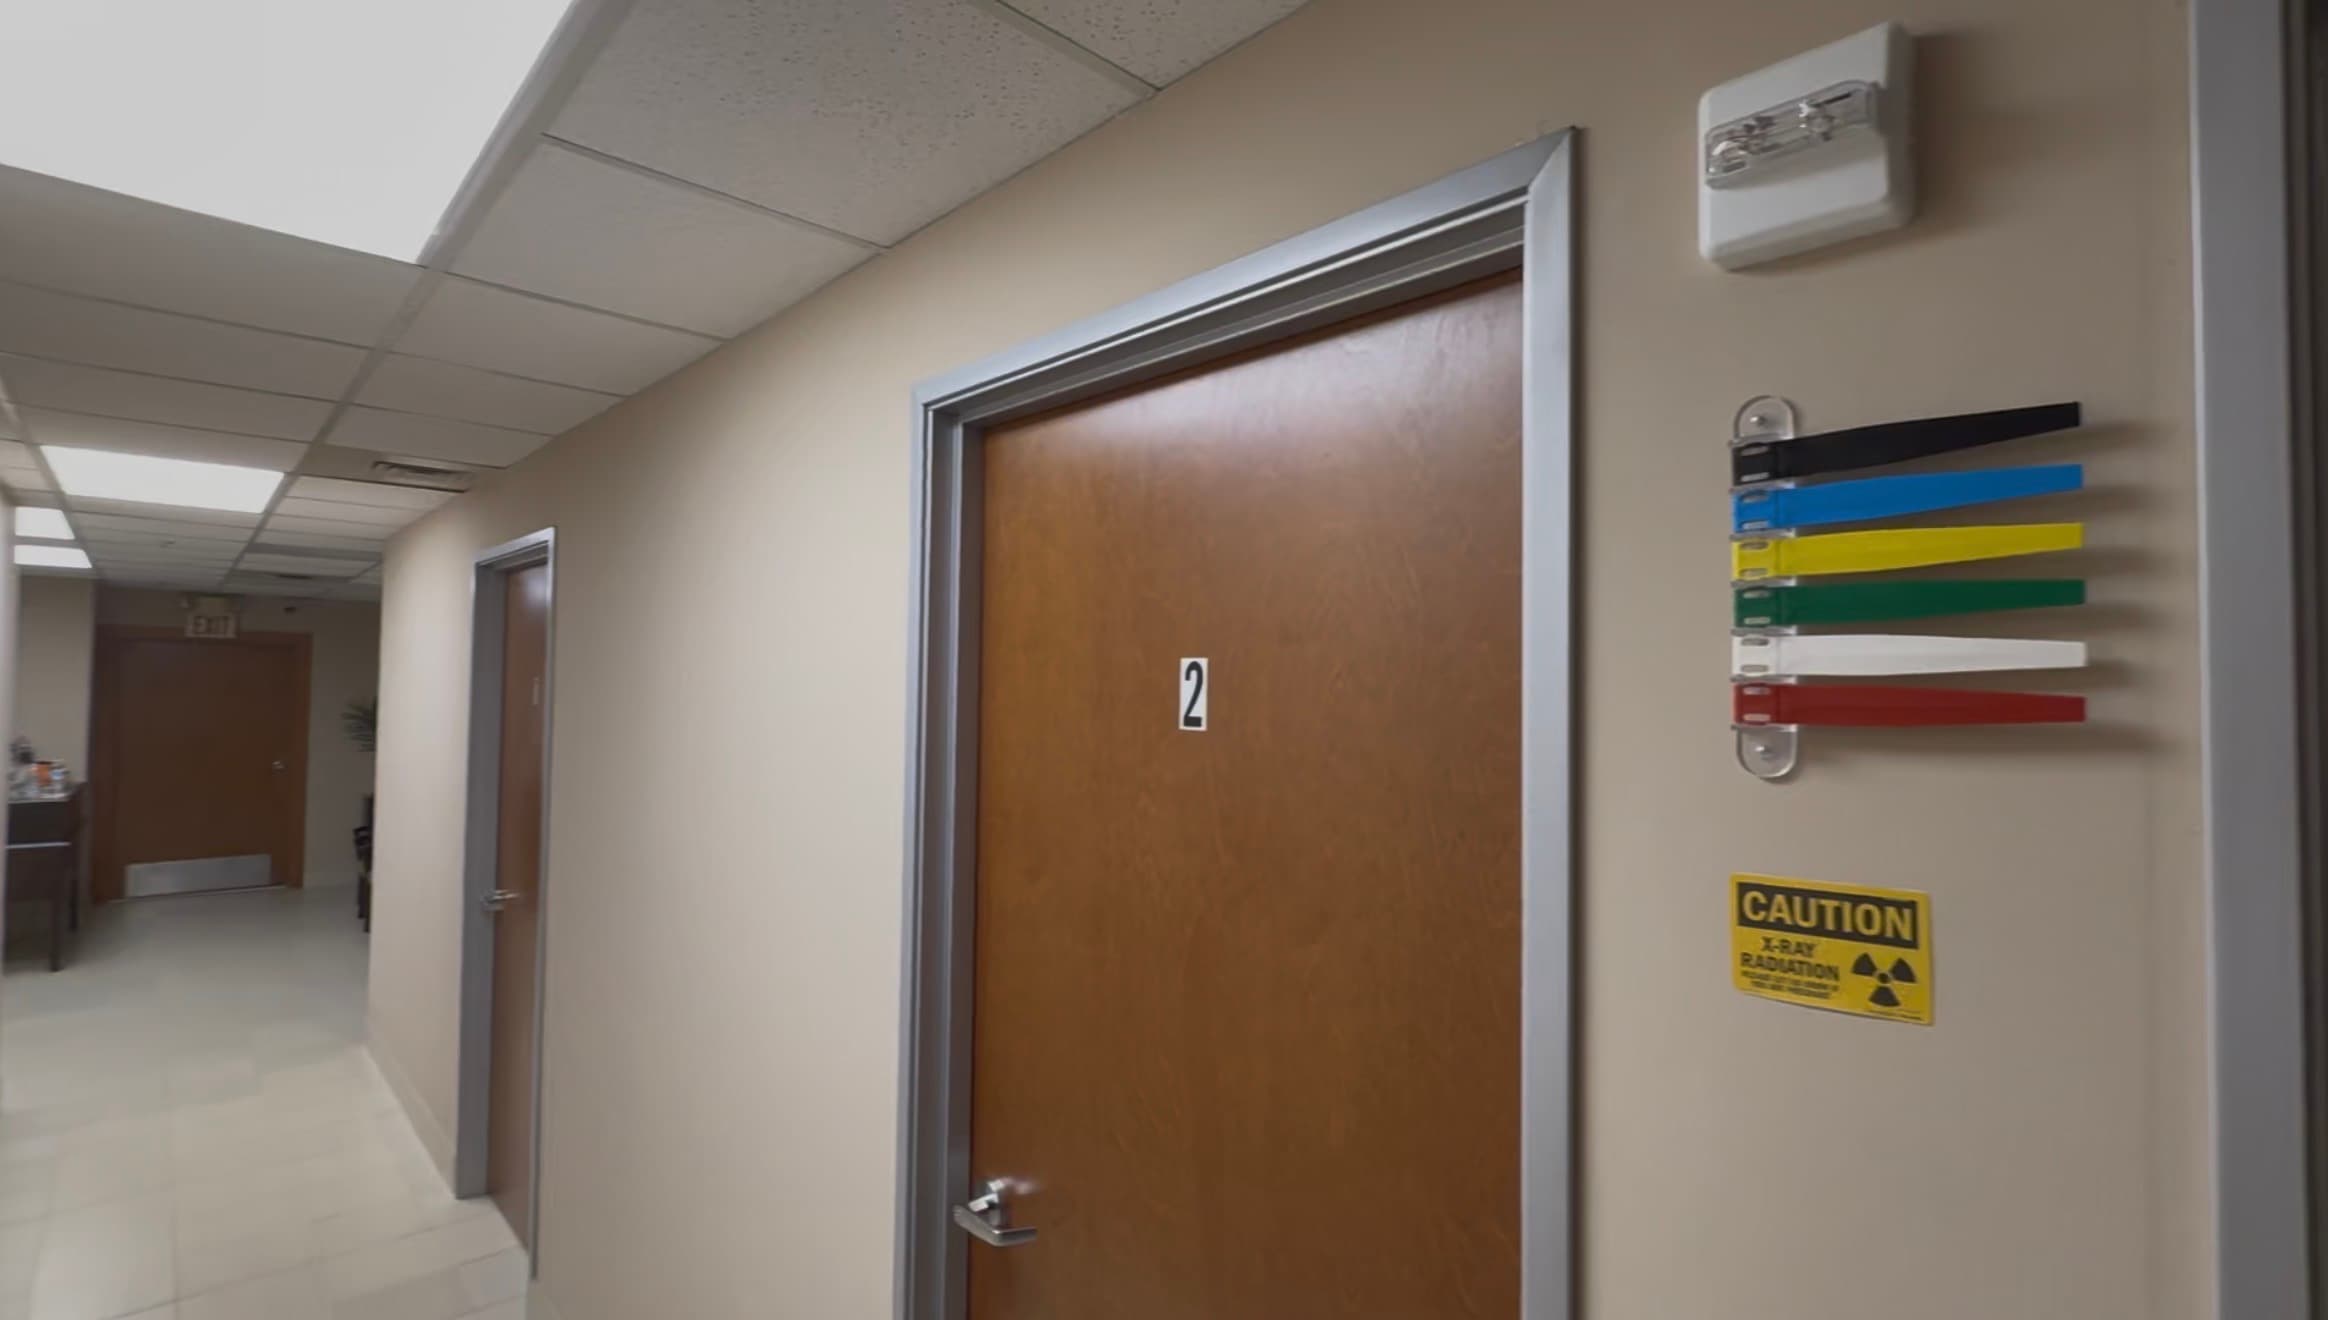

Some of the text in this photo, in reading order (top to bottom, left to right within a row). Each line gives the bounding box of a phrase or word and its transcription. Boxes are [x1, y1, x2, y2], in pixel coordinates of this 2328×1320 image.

[193, 615, 230, 634] EXIT
[1184, 661, 1203, 727] 2
[1743, 891, 1913, 941] CAUTION
[1761, 936, 1817, 958] X-RAY
[1741, 952, 1839, 981] RADIATION
